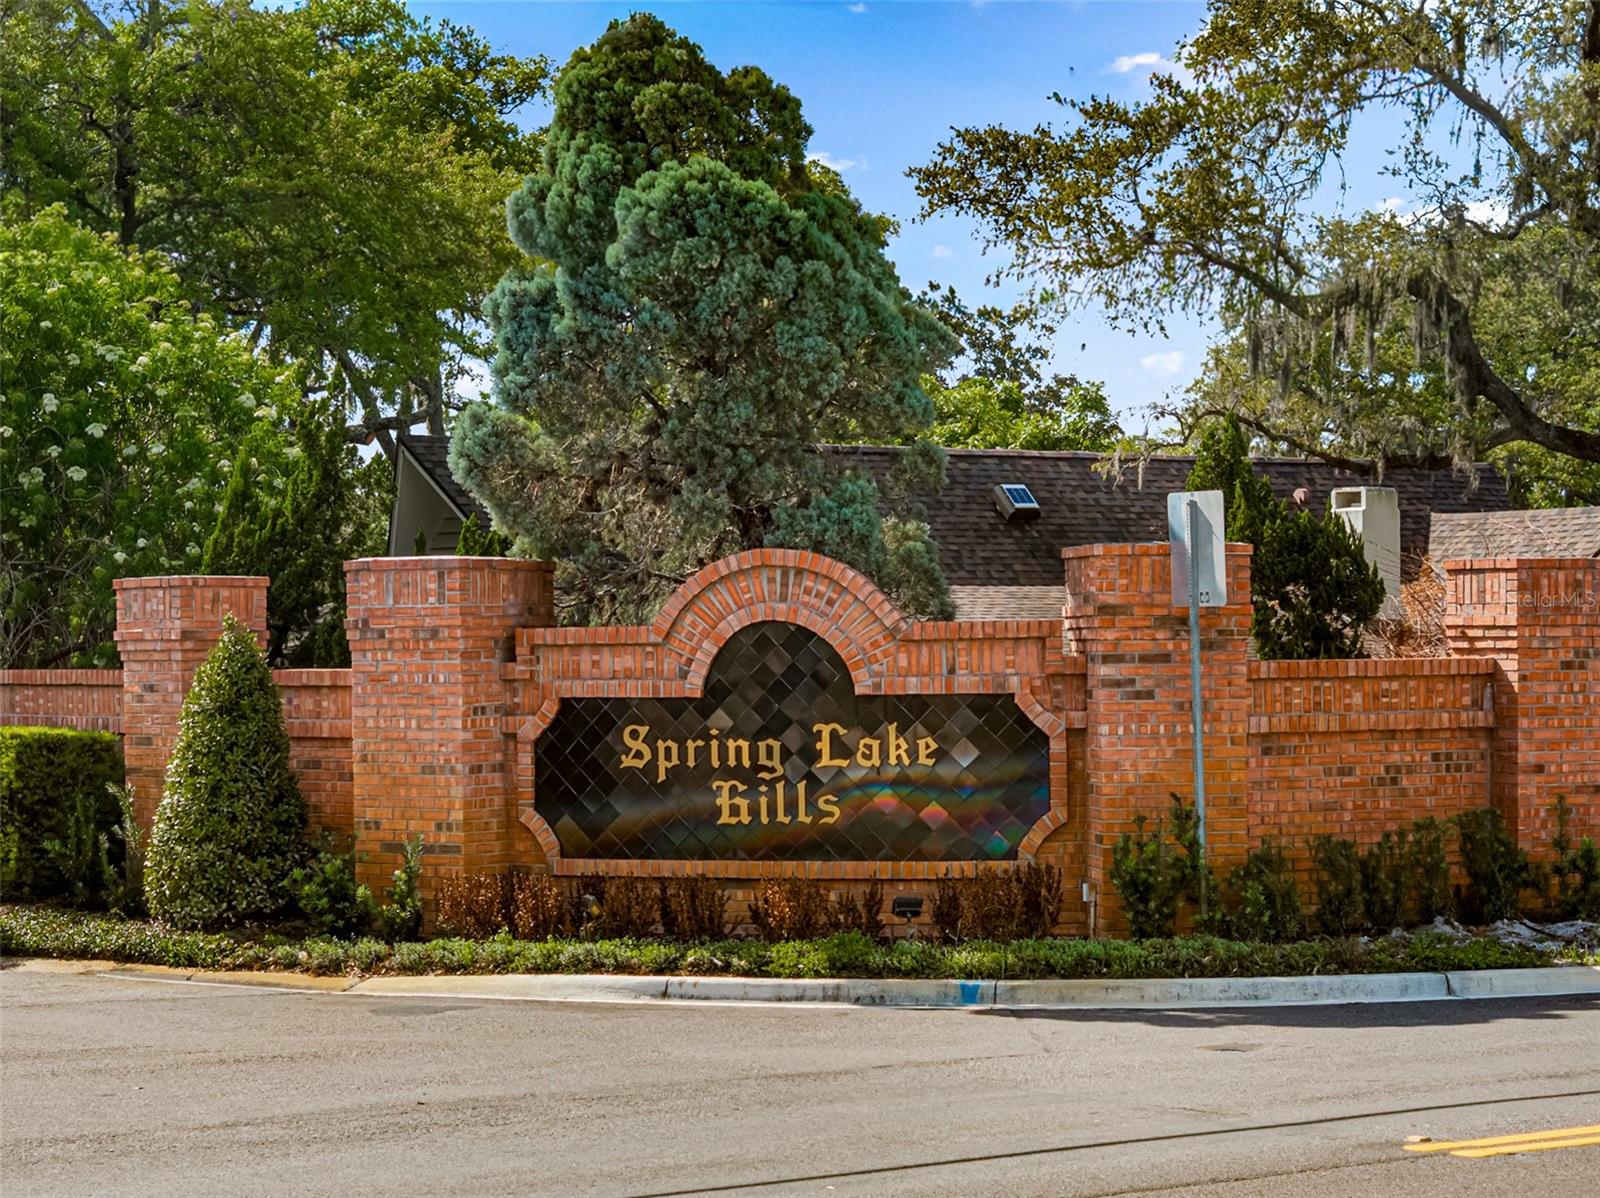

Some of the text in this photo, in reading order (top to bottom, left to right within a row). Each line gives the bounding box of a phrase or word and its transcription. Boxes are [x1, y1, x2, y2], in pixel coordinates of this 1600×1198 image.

[619, 722, 939, 783] Spring Lake
[712, 779, 842, 825] Hills
